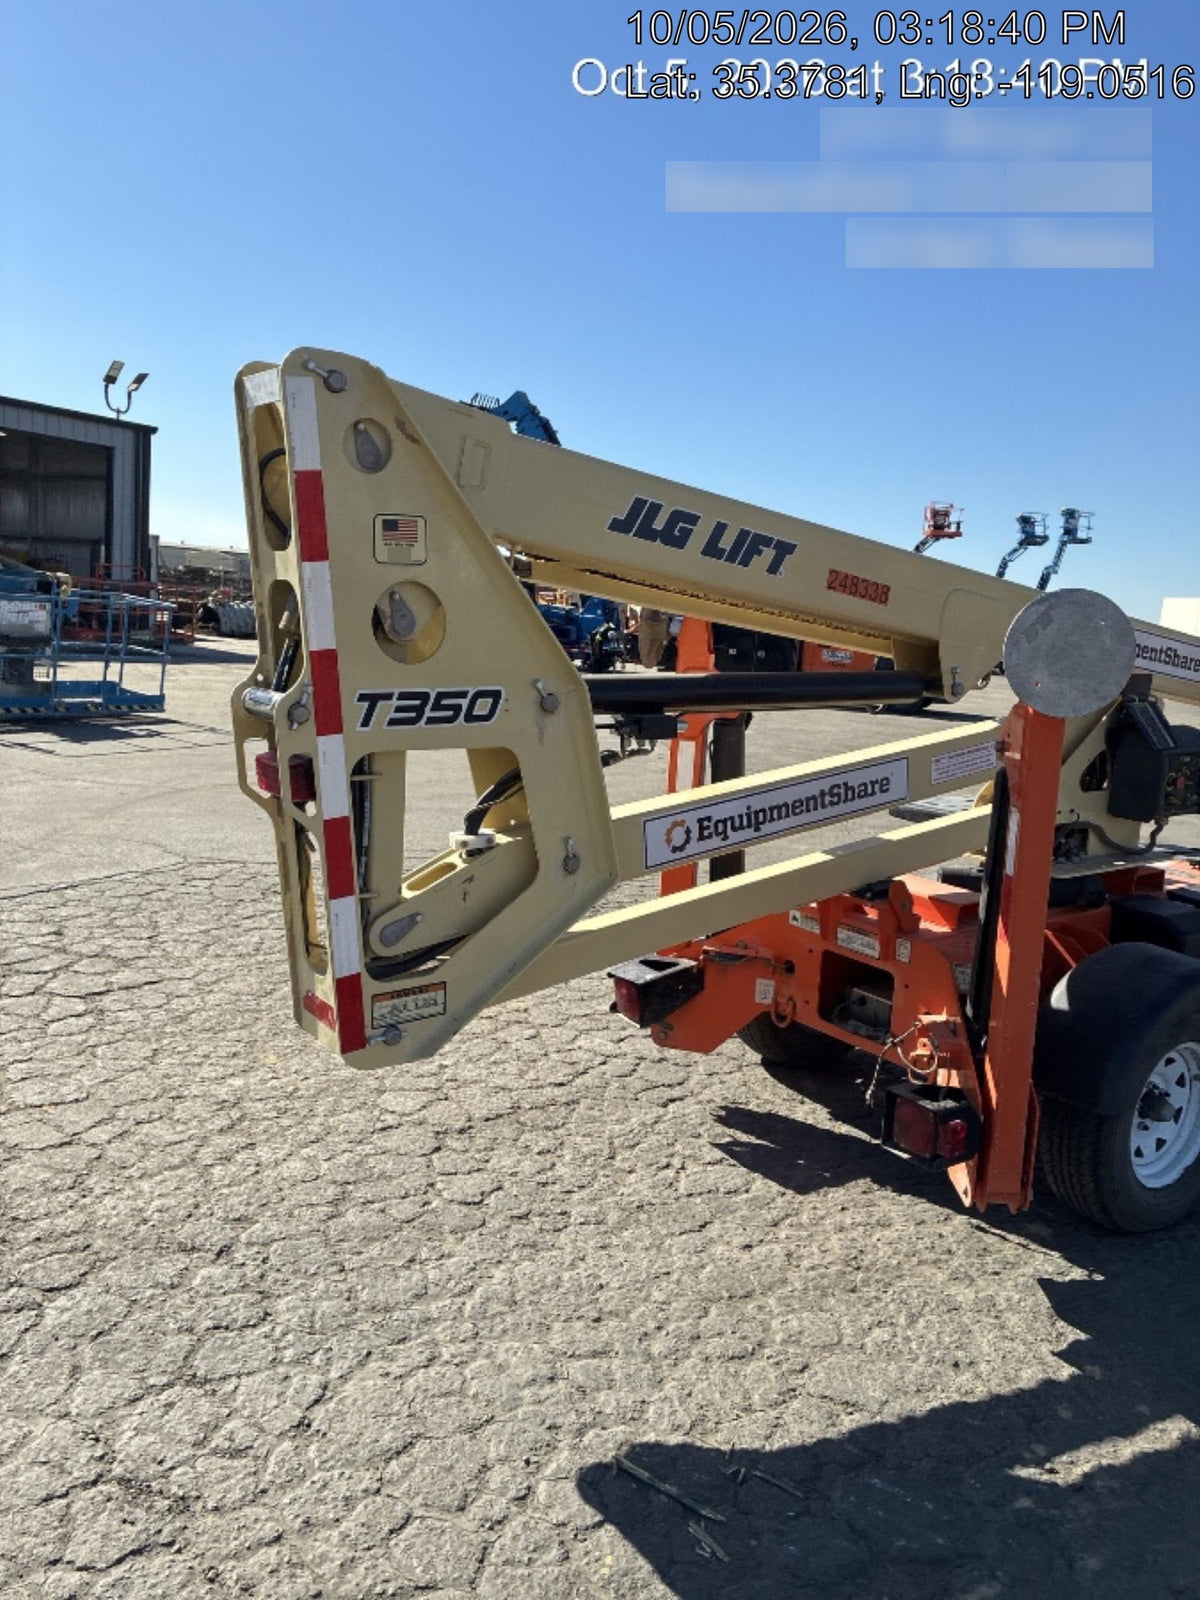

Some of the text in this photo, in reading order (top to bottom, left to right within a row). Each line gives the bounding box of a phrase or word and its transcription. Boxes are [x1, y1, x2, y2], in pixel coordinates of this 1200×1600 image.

[607, 496, 798, 576] JLG LIFT
[826, 568, 891, 605] 248338
[355, 687, 504, 730] T350
[696, 775, 892, 844] EquipmentShare
